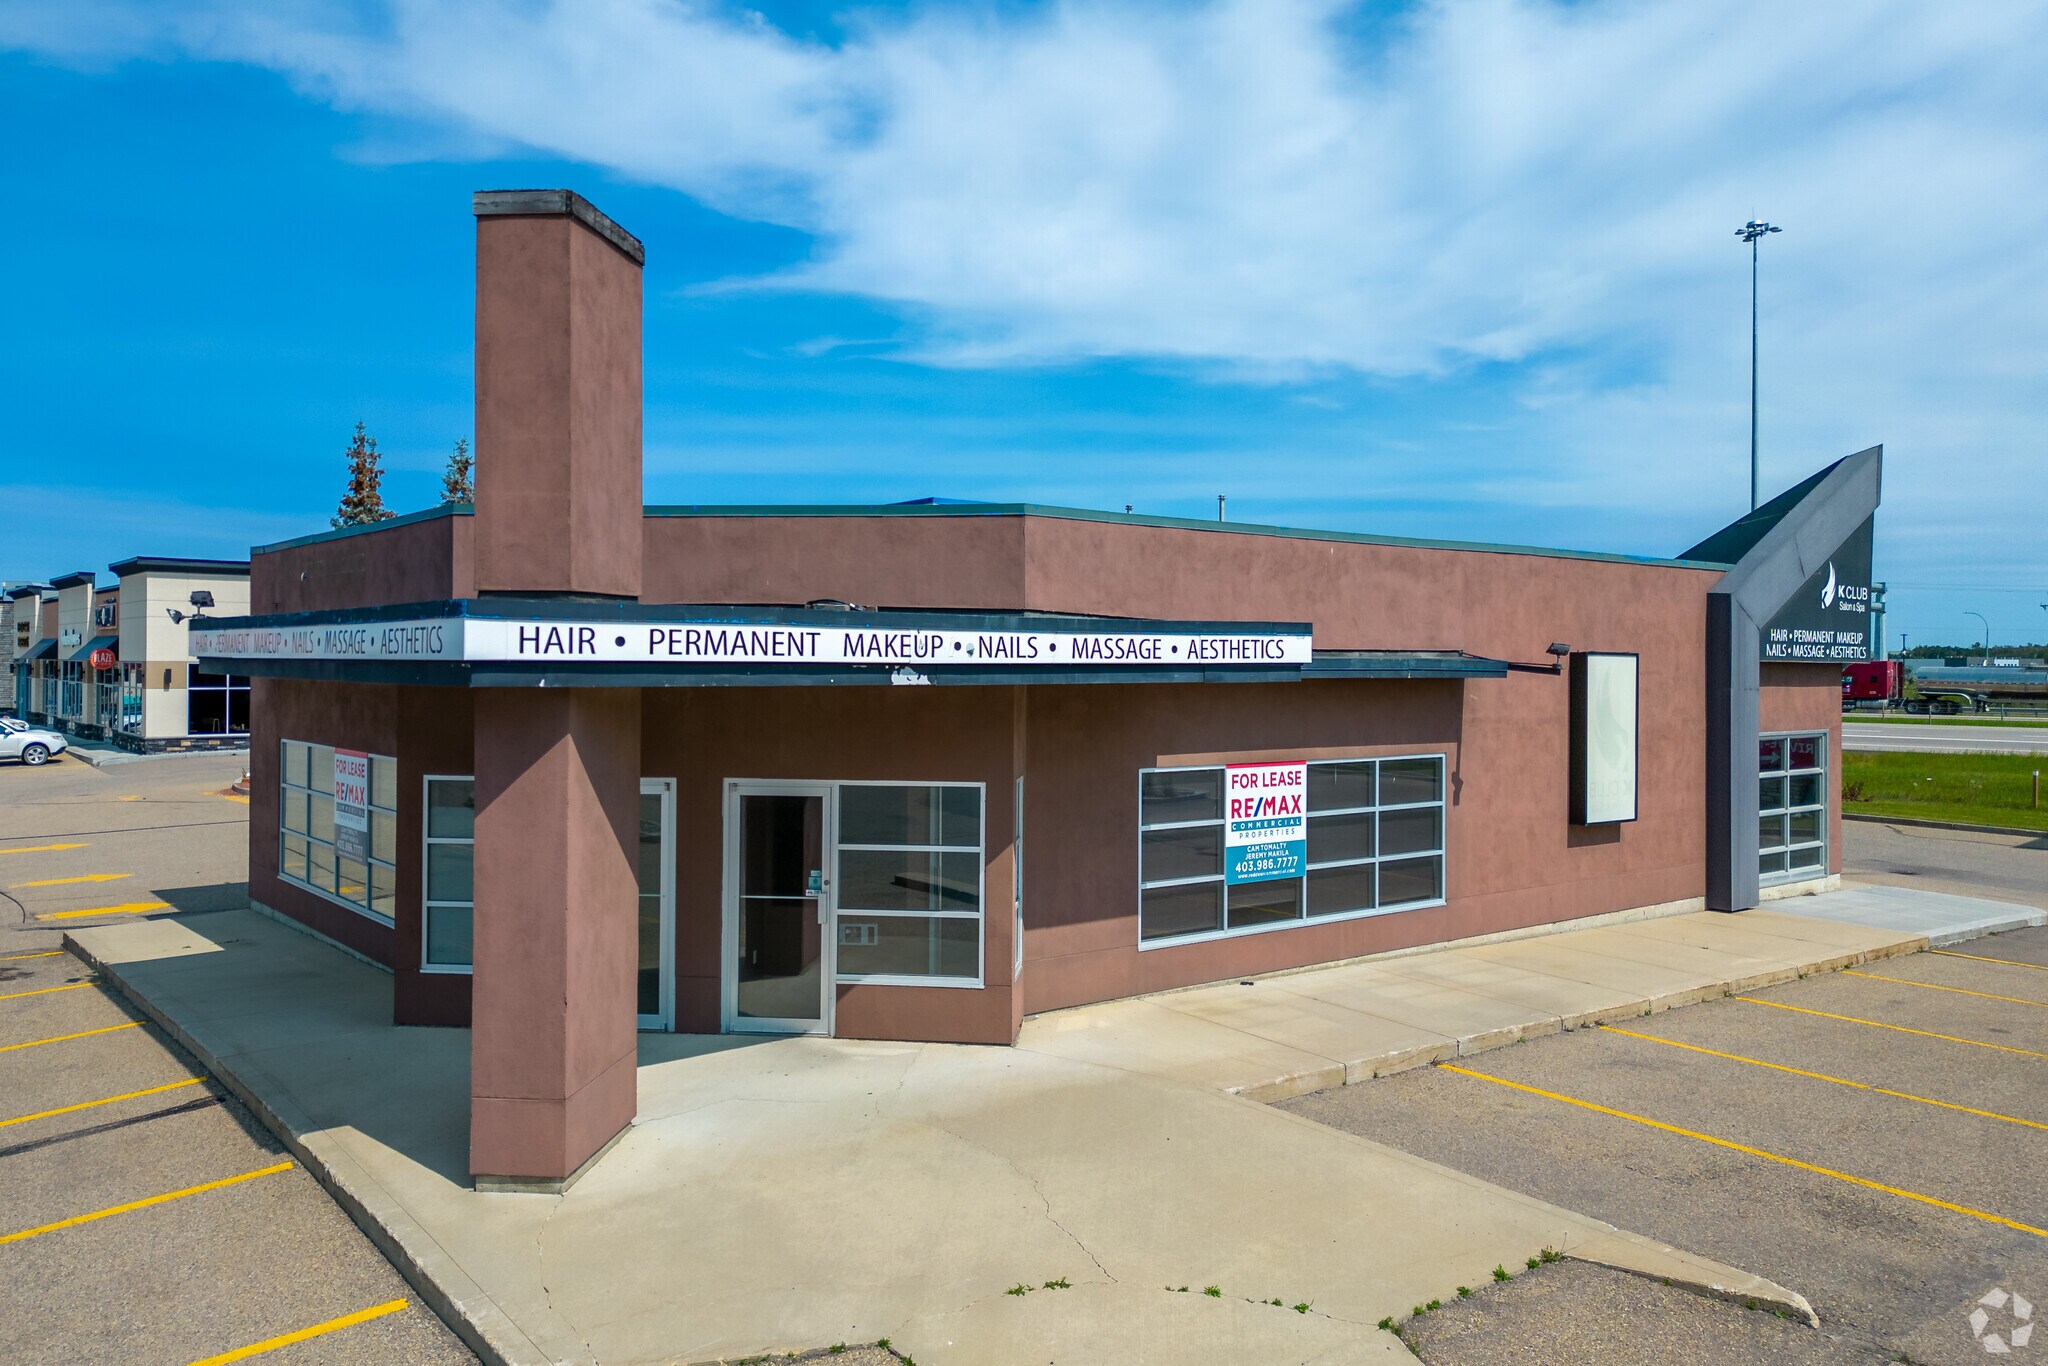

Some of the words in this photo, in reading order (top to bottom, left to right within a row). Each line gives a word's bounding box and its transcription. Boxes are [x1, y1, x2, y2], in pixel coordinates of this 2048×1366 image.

[1838, 585, 1845, 598] K
[1846, 586, 1868, 600] CLUB
[1839, 601, 1852, 611] Salon
[1856, 602, 1865, 613] Spa
[195, 634, 209, 653] HAIR
[253, 632, 281, 654] MAKEUP
[292, 630, 314, 654] NAILS
[324, 629, 366, 655] MASSAGE
[380, 626, 443, 655] AESTHETICS
[518, 626, 597, 655] HAIR
[649, 629, 821, 658] PERMANENT
[843, 633, 944, 659] MAKEUP
[978, 636, 1038, 659] NAILS
[1072, 637, 1162, 660] MASSAGE
[1187, 639, 1285, 660] AESTHETICS
[1770, 629, 1788, 642] HAIR
[1794, 630, 1834, 643] PERMANENT
[1837, 632, 1863, 645] MAKEUP
[1766, 644, 1787, 657] NAILS
[1792, 645, 1825, 658] MASSAGE
[1830, 646, 1867, 659] AESTHETICS
[336, 759, 346, 774] FOR
[348, 761, 365, 778] LEASE
[1231, 772, 1259, 790] FOR
[1262, 770, 1302, 788] LEASE
[336, 781, 365, 806] RE/MAX
[1231, 794, 1302, 819] RE/MAX
[1232, 819, 1300, 831] COMMERCIAL
[1239, 828, 1295, 840] PROPERTIES
[1247, 845, 1260, 853] CAM
[1260, 842, 1287, 851] TOMALTY
[1235, 856, 1298, 873] 403.986.7777
[1245, 852, 1267, 861] JEREMY
